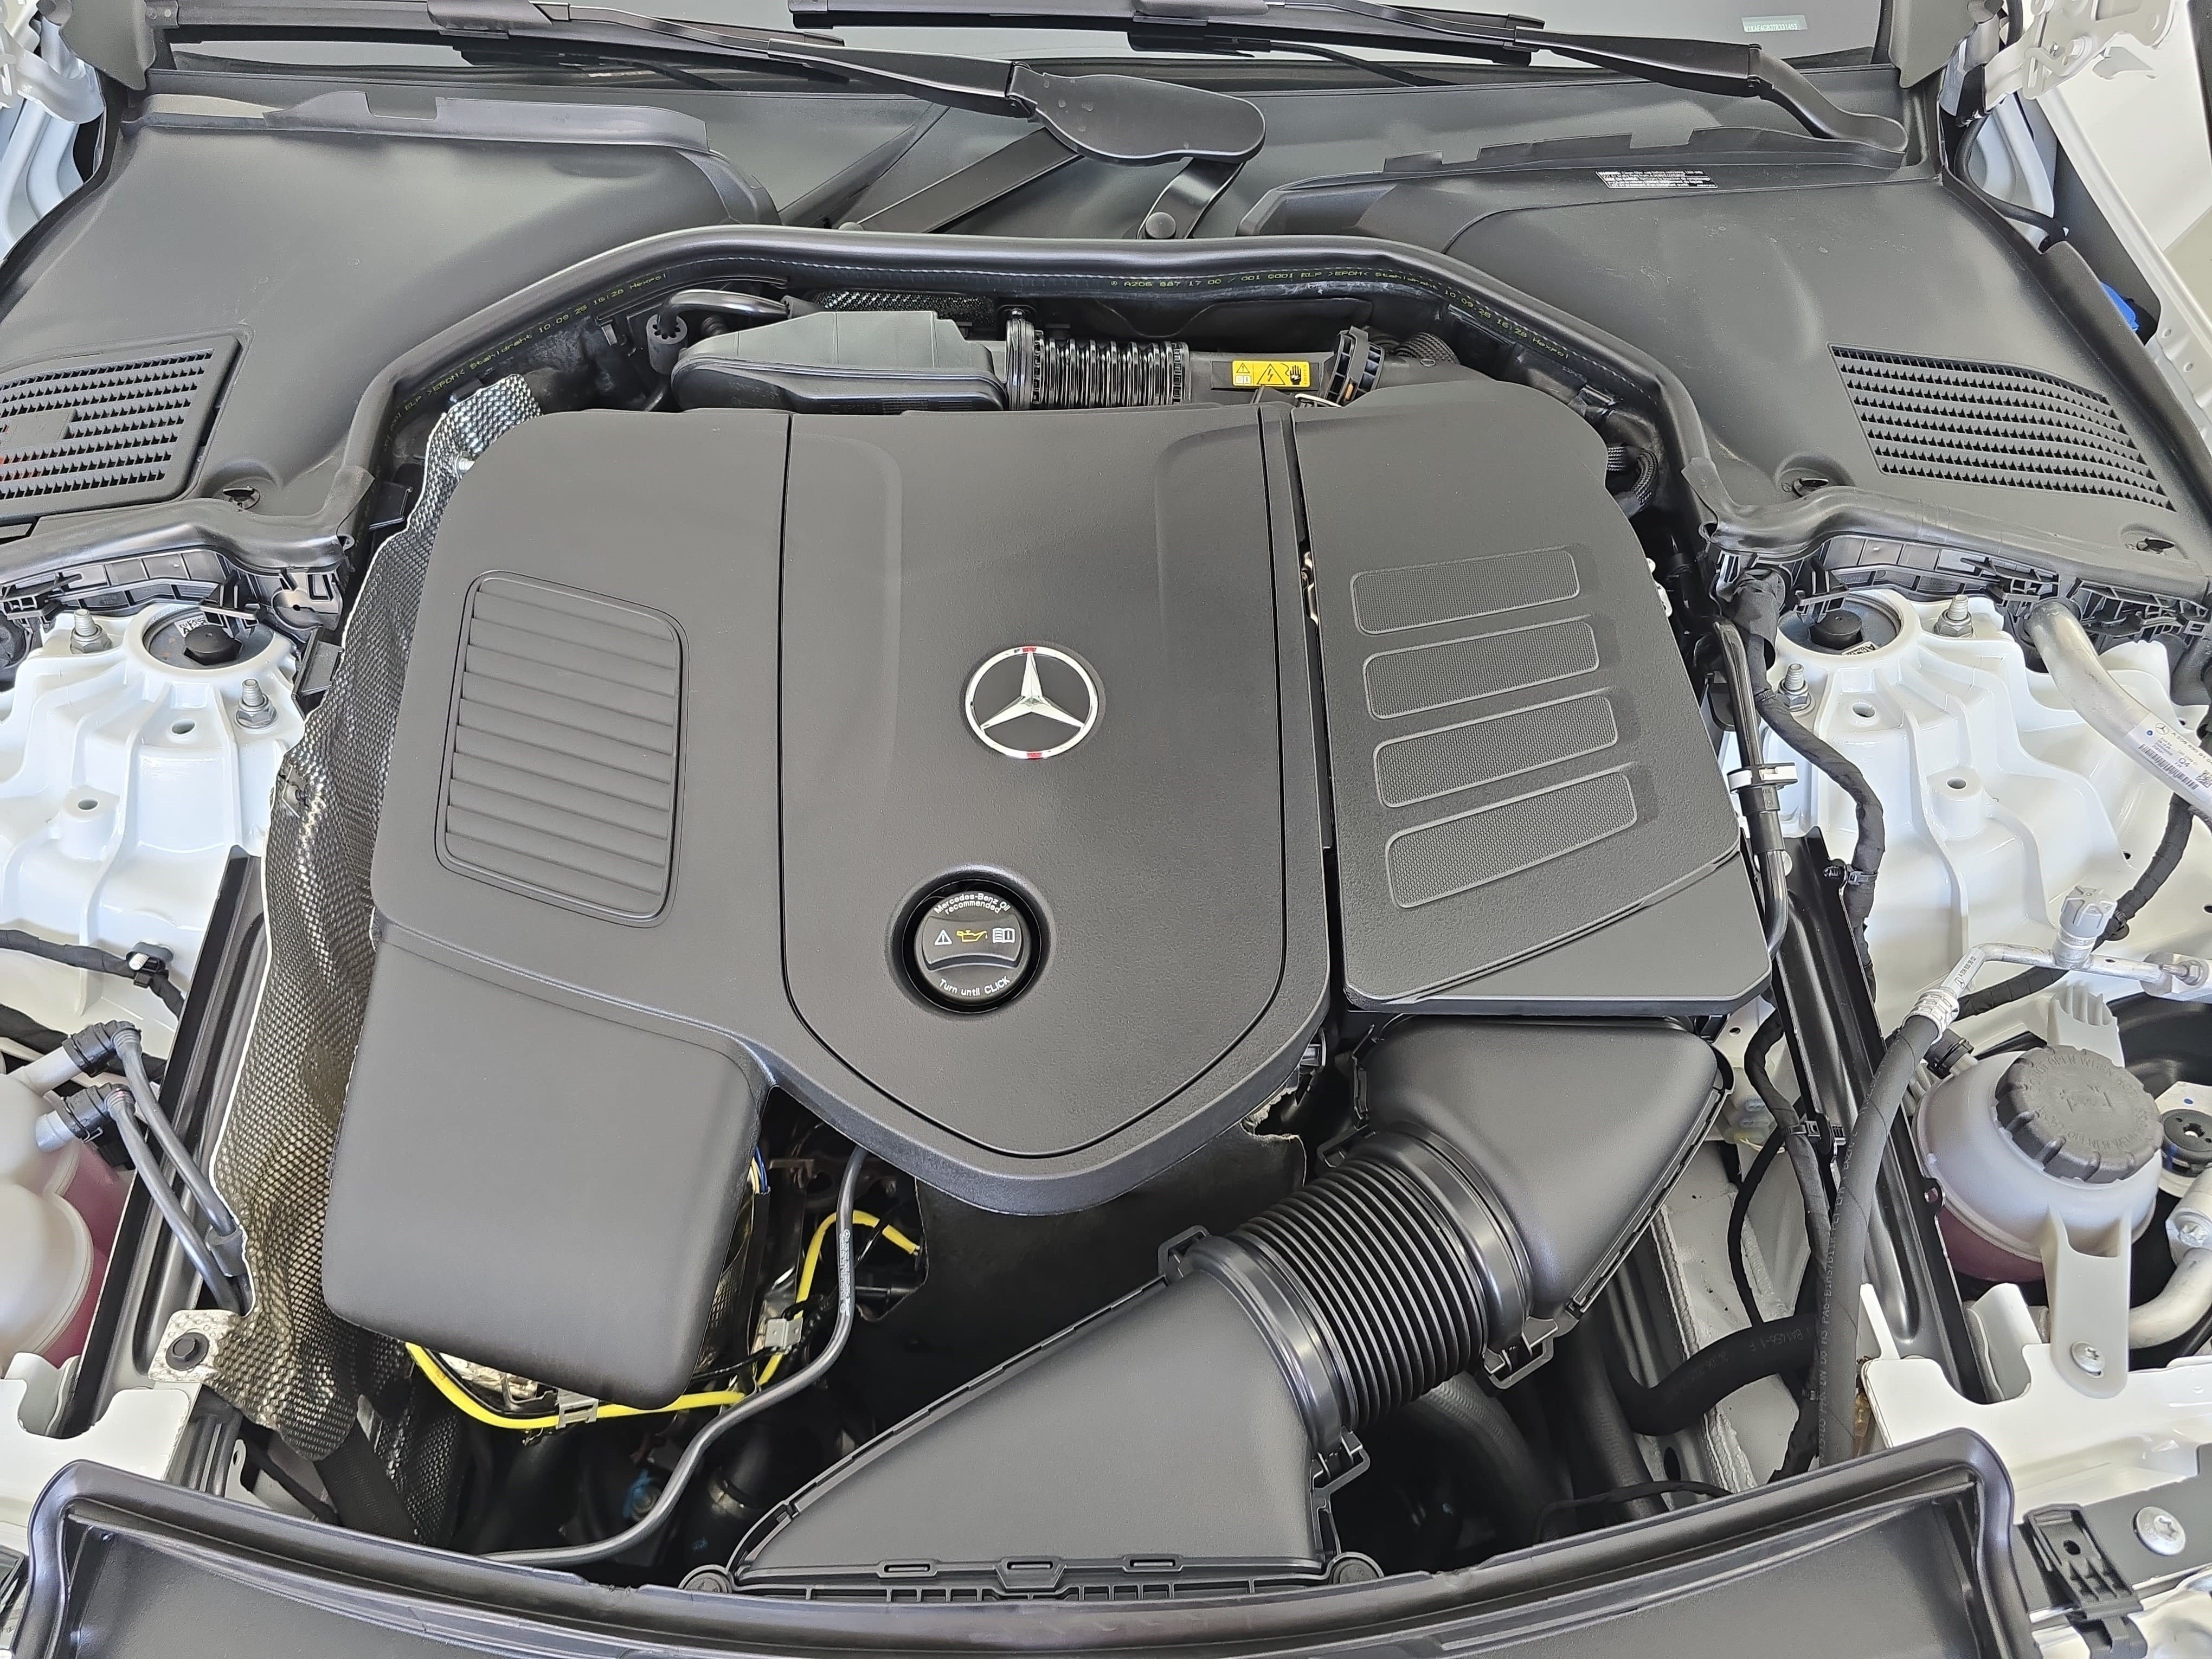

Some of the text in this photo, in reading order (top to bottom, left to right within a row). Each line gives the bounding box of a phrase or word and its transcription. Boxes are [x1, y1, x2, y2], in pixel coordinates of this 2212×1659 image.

[934, 893, 1011, 914] Mercedes-Benz Oil
[944, 901, 1001, 915] recommended
[940, 976, 1010, 996] Turn until CLICK
